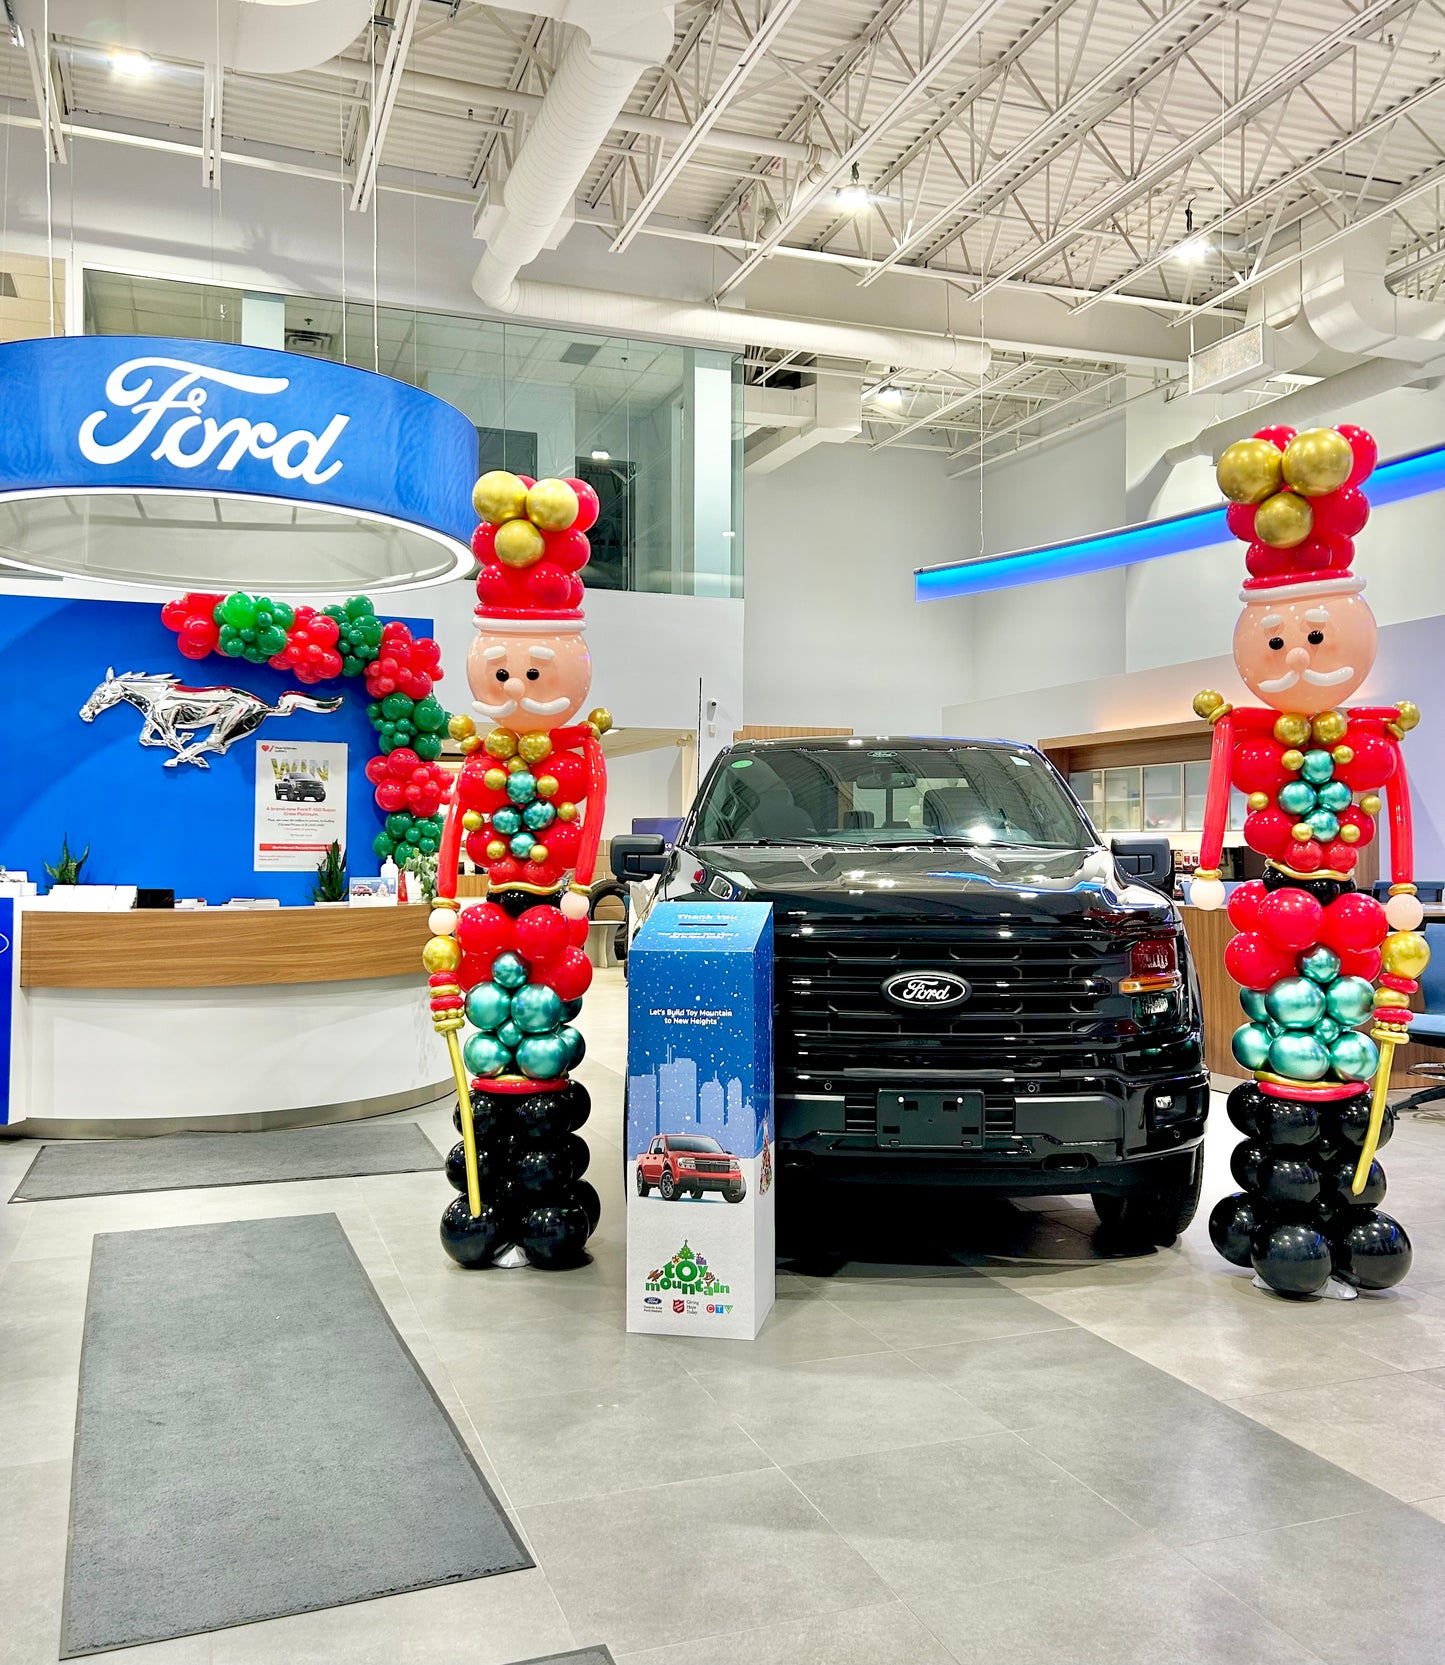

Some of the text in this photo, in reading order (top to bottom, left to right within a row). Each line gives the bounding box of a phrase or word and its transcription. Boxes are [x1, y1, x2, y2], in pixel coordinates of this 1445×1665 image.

[78, 356, 351, 485] Ford
[271, 758, 329, 781] WIN
[903, 980, 950, 1000] Ford
[649, 1008, 733, 1017] Let's Build Toy Mountain
[690, 1018, 717, 1026] Heights
[663, 1260, 708, 1282] toy
[645, 1278, 730, 1296] mountain
[706, 1304, 733, 1314] CTV
